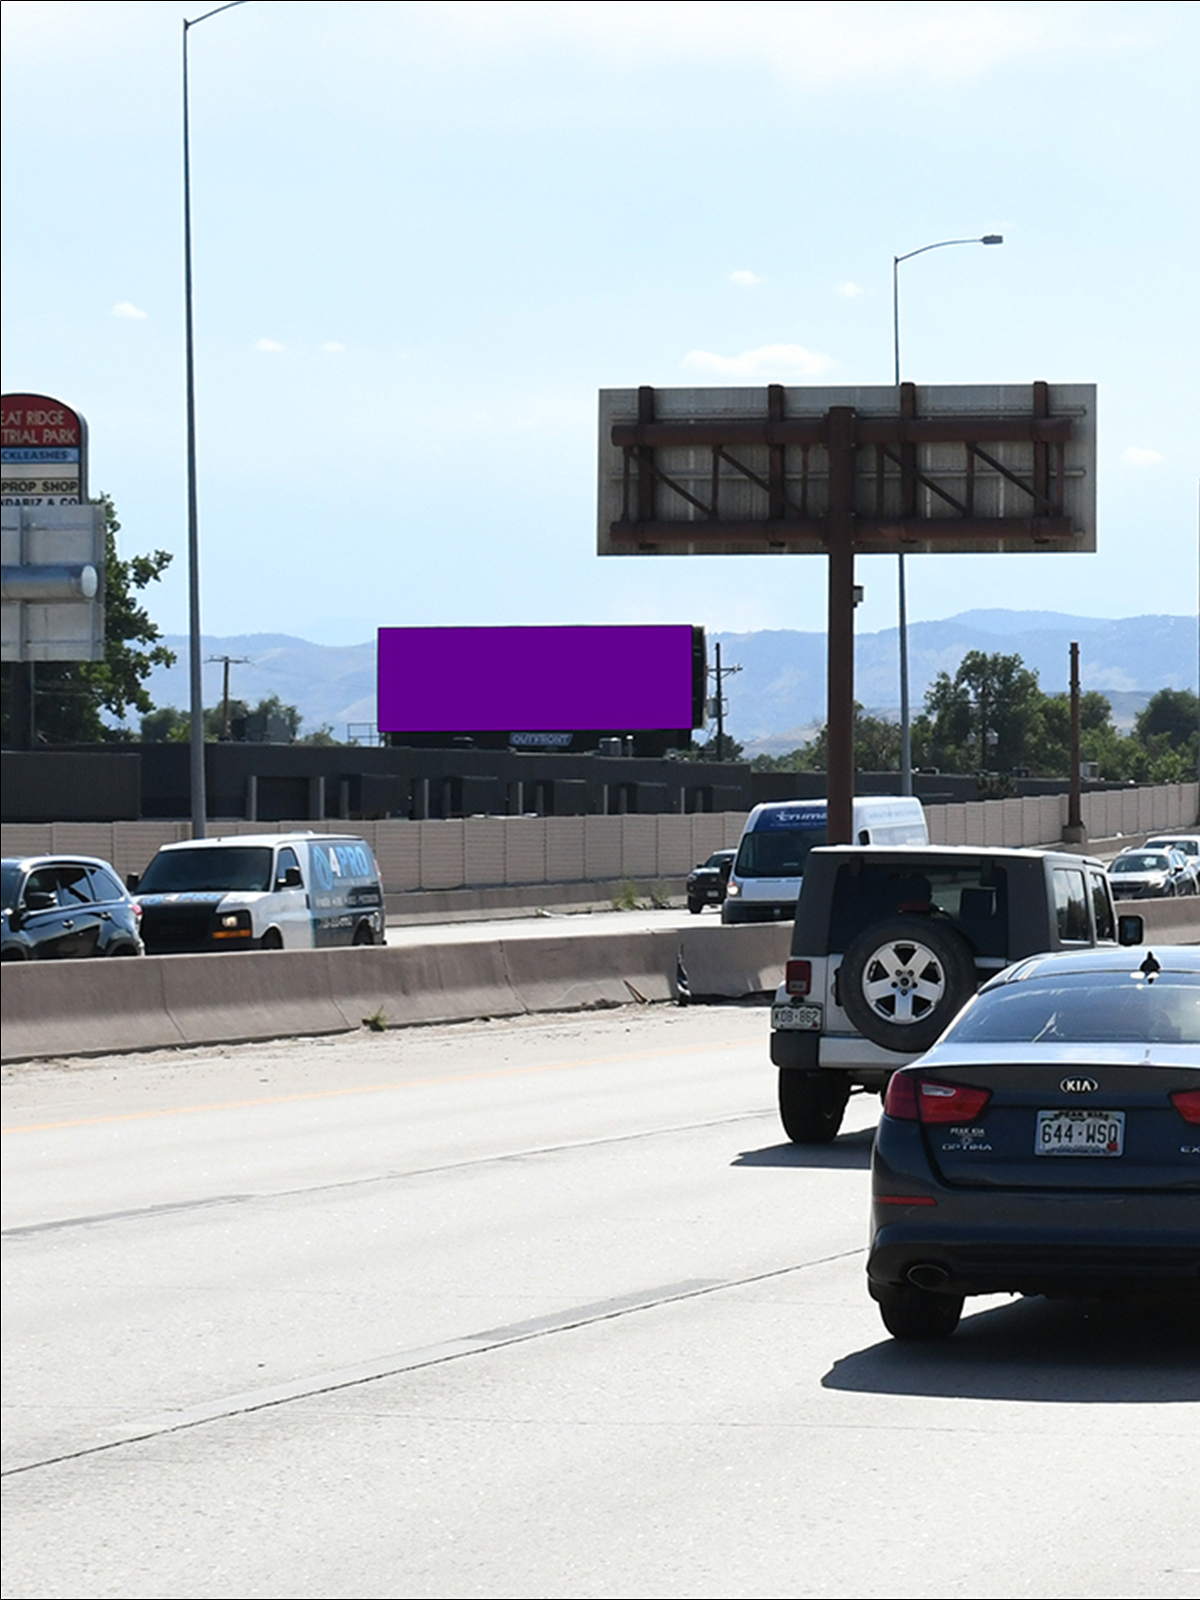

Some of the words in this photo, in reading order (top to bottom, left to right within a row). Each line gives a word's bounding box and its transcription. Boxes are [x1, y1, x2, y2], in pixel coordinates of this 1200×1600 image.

[26, 410, 65, 426] RIDGE
[1, 428, 39, 444] TRIAL
[43, 429, 76, 444] PARK
[2, 481, 37, 492] PROP
[42, 481, 78, 492] SHOP
[512, 733, 570, 746] OUTFRONT
[329, 845, 371, 878] 4PRO
[1064, 1079, 1093, 1092] KIA
[942, 1143, 992, 1151] OPTIMA
